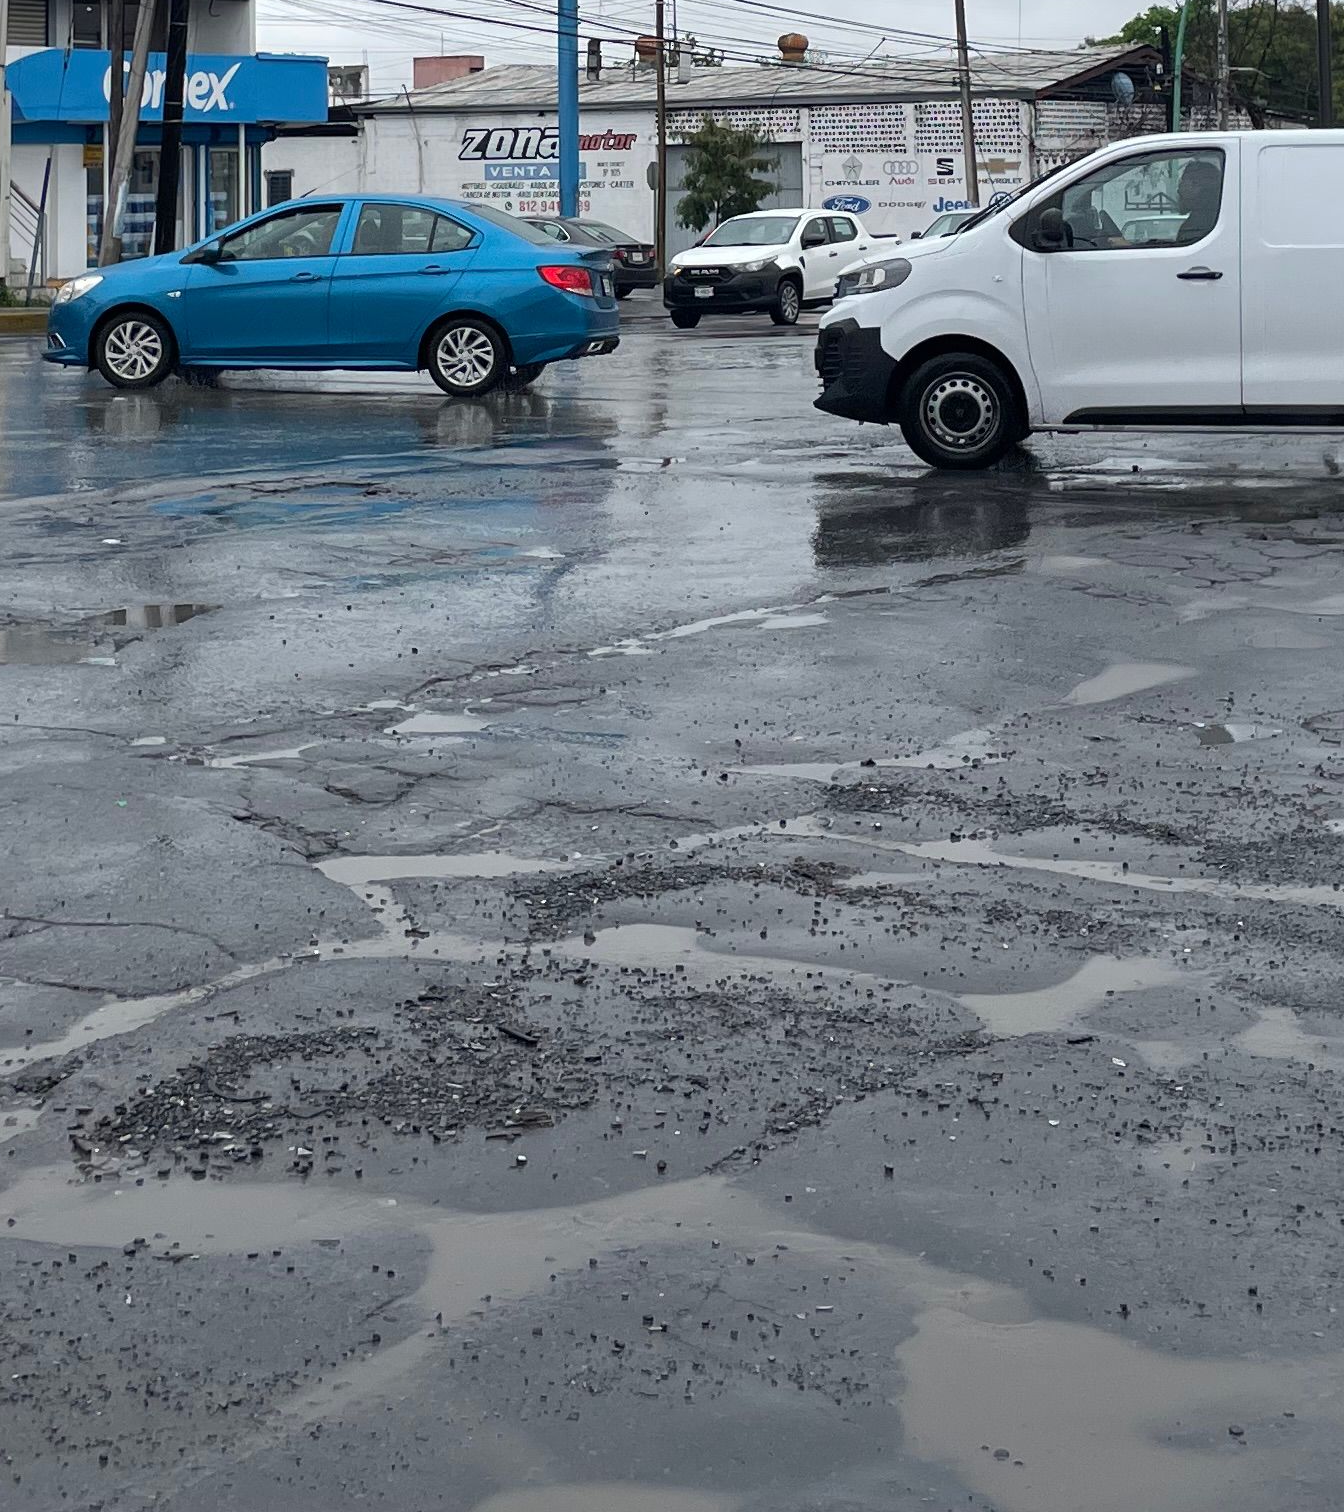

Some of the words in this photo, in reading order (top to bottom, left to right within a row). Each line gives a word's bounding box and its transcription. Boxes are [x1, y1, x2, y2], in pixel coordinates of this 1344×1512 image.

[489, 166, 552, 178] VENTA
[927, 177, 963, 185] SEAT
[977, 177, 1024, 185] HEVROLET
[519, 200, 537, 213] 812
